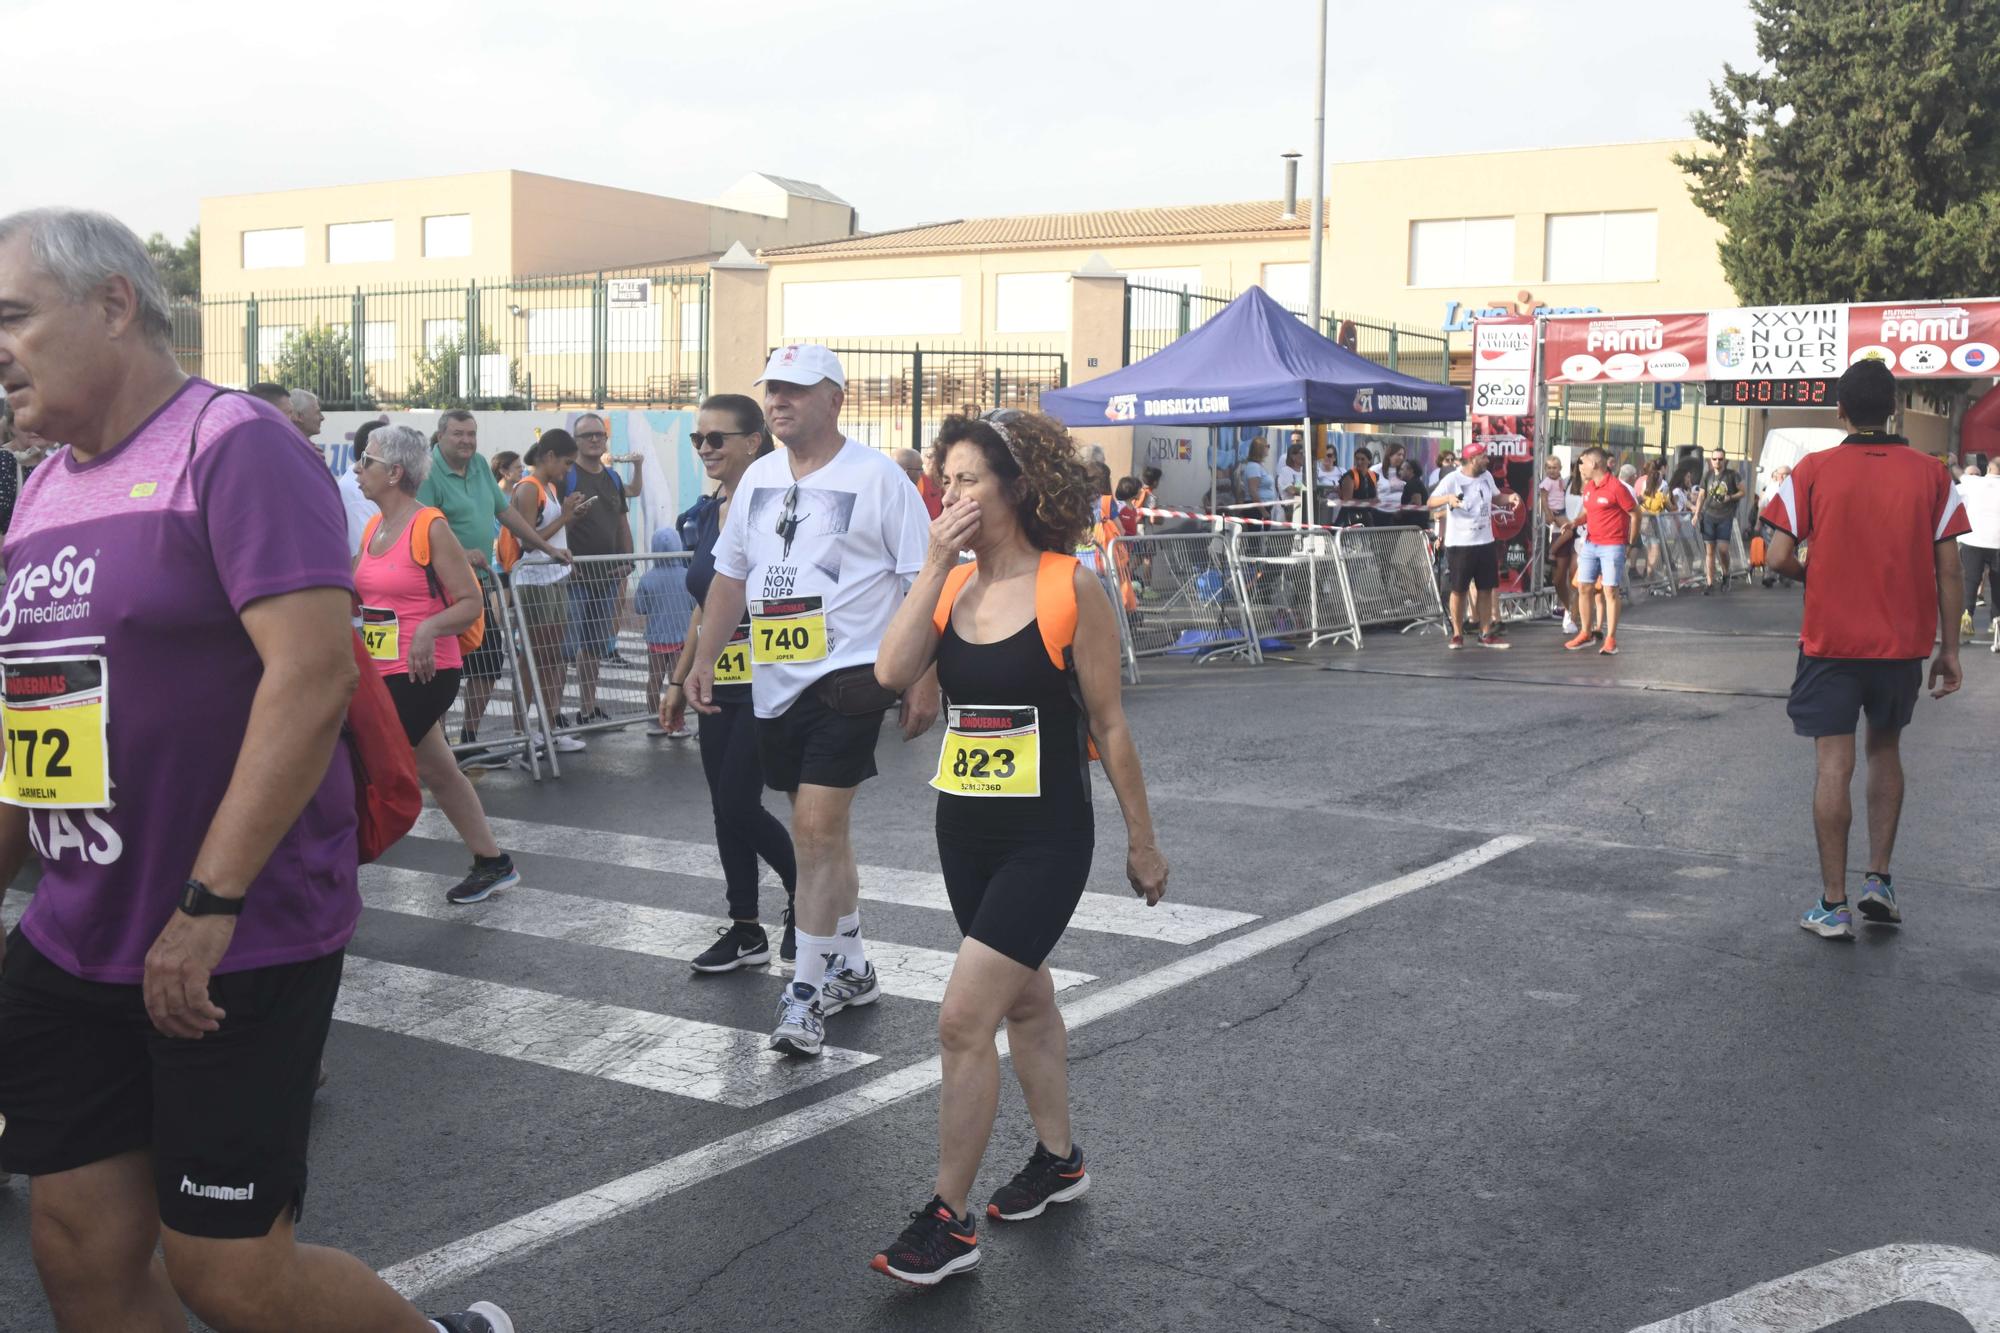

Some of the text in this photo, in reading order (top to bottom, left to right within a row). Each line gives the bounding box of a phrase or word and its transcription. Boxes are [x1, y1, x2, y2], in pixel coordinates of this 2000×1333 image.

[1752, 310, 1837, 327] XXVIII
[1587, 329, 1663, 352] FAMU
[1752, 326, 1837, 343] NON
[1881, 318, 1969, 343] FAMU
[1752, 342, 1837, 359] DUER
[1751, 358, 1837, 375] MAS
[1660, 382, 1676, 407] P
[1735, 380, 1826, 402] 0:01:32
[1144, 396, 1230, 416] DORSAL21.COM
[1377, 394, 1428, 412] DORSAL21.COM
[768, 565, 798, 576] XXVIII
[764, 575, 796, 588] NON
[18, 597, 90, 624] mediación
[761, 627, 809, 651] 740
[953, 748, 1016, 778] 823
[180, 1175, 255, 1200] hummel
